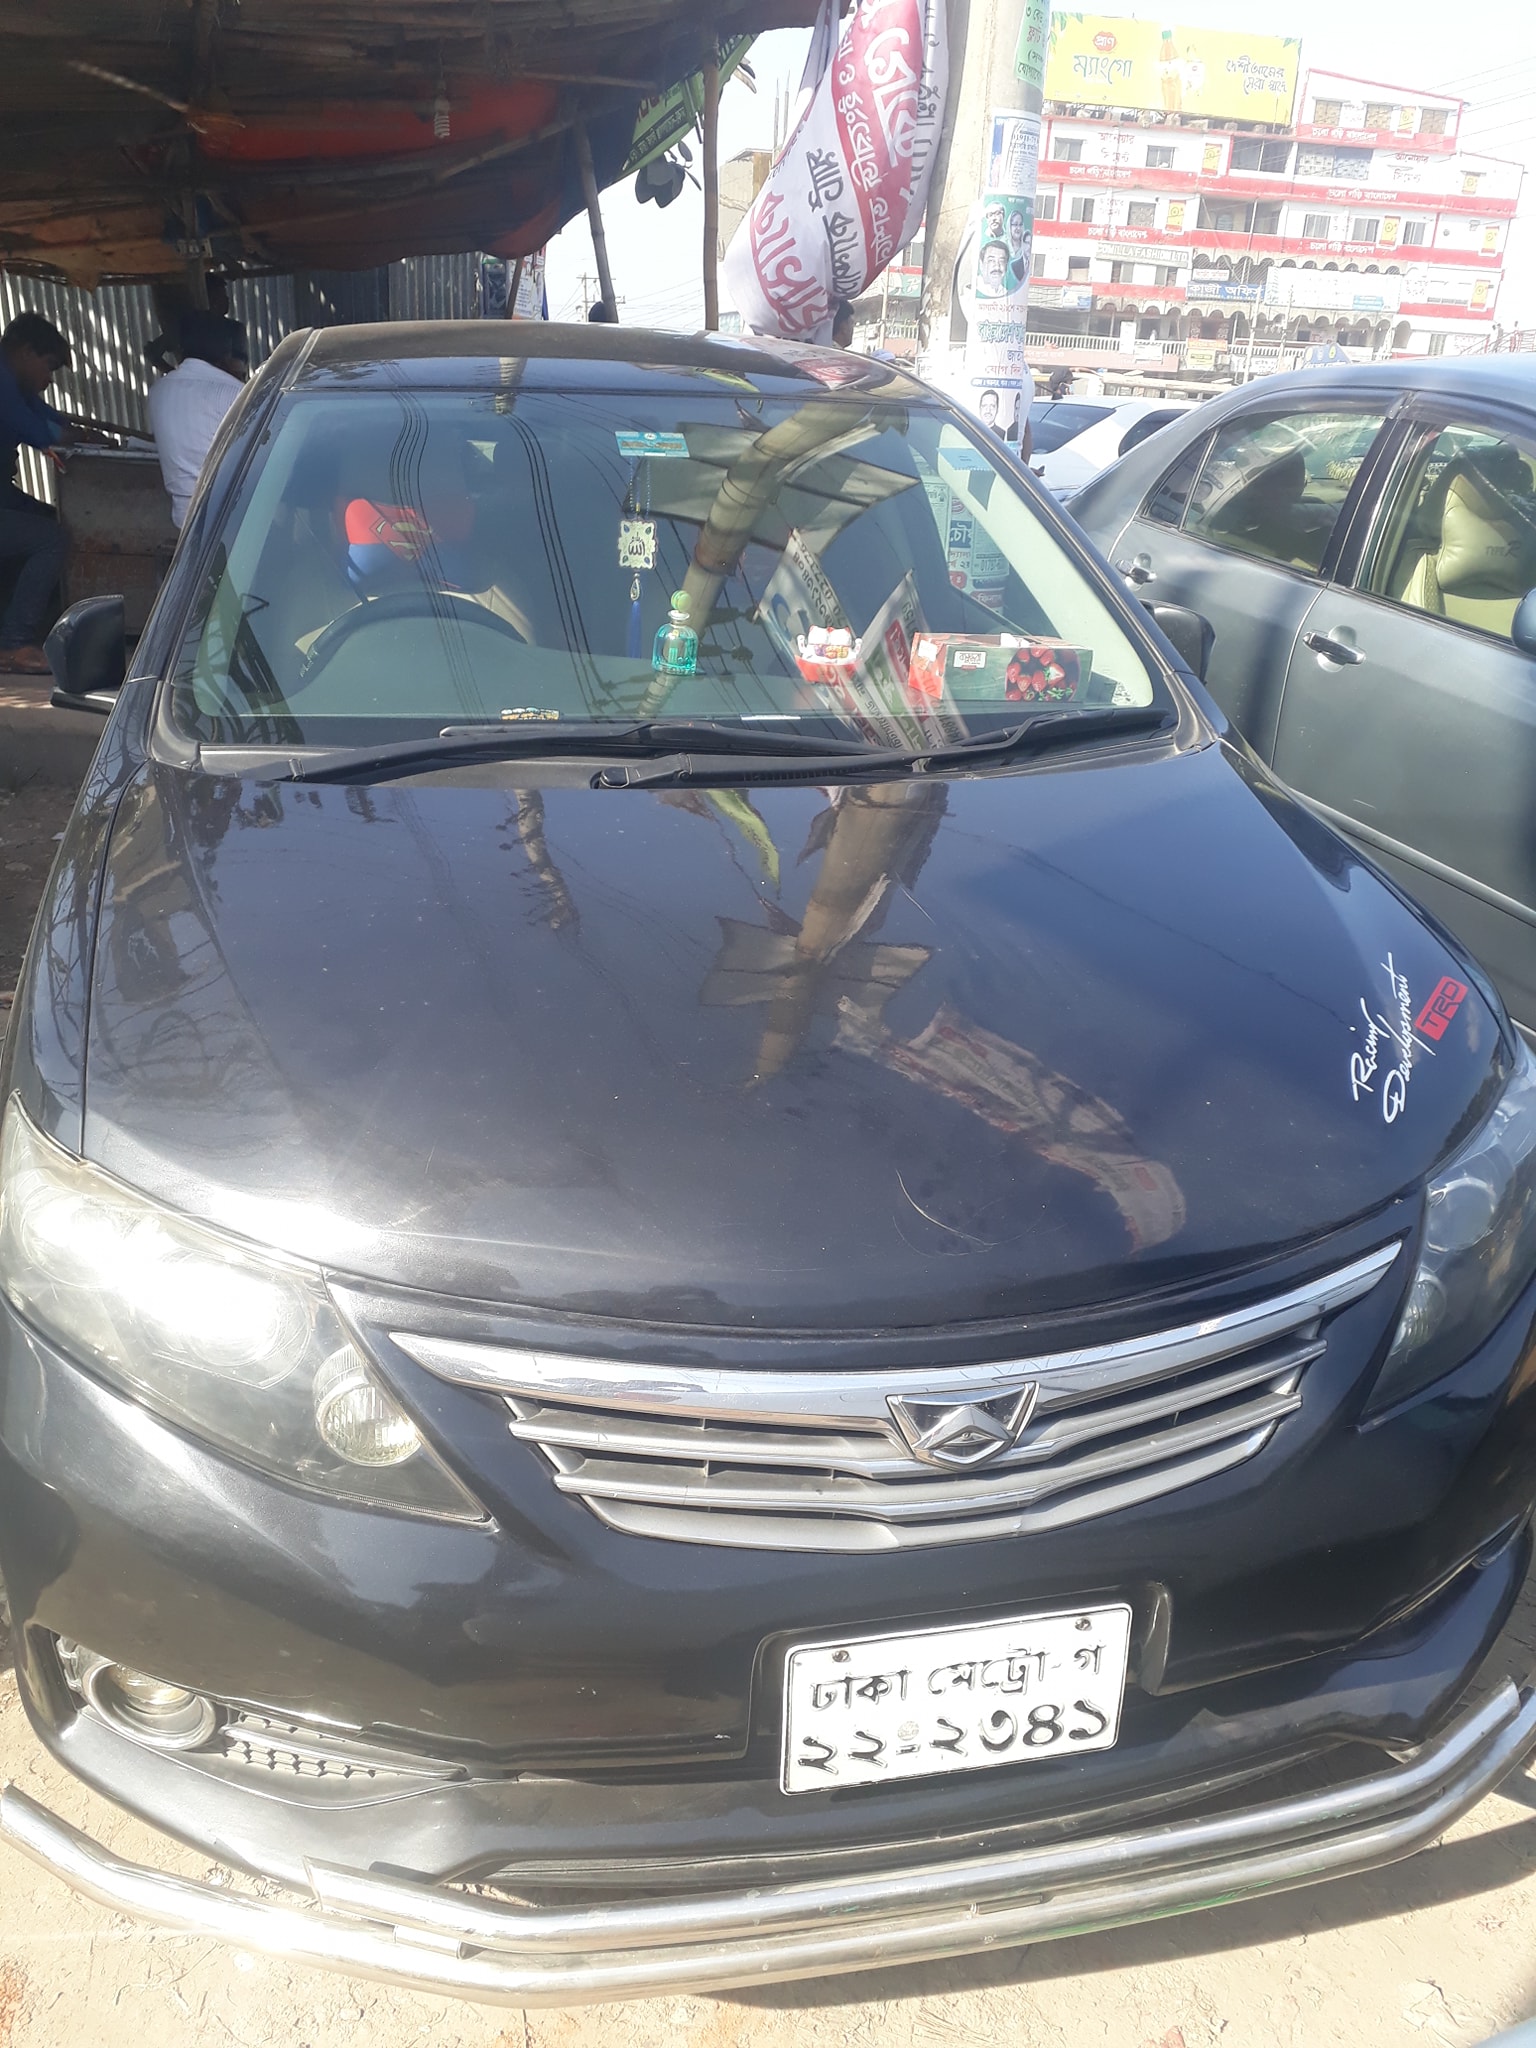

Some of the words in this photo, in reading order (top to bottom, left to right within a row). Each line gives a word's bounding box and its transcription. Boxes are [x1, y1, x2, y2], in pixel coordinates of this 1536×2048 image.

[1094, 34, 1115, 47] প্রাণ
[1072, 54, 1133, 85] ম্যাংগো
[1135, 247, 1171, 261] FASHION
[1171, 251, 1188, 262] LTD
[1188, 283, 1222, 294] কাজী
[1421, 980, 1462, 1029] TRD
[1349, 997, 1390, 1101] Racing
[810, 1669, 912, 1712] ঢাকা
